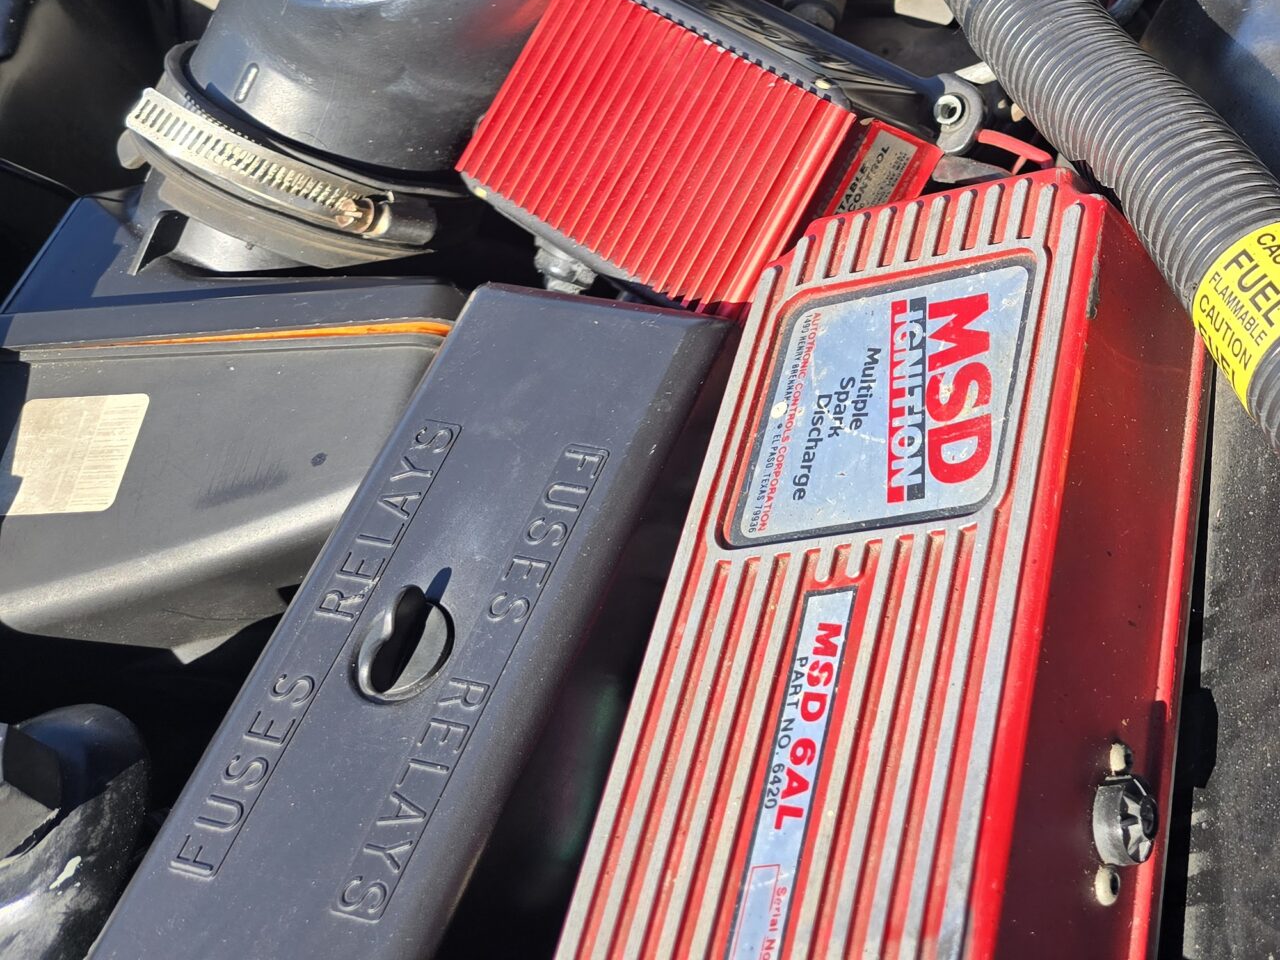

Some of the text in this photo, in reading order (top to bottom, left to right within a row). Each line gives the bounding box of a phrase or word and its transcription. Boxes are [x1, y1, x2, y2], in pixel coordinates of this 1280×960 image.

[800, 312, 822, 378] AUTOTRONIC
[1199, 294, 1252, 371] CAUTION
[1208, 271, 1268, 347] FLAMMABLE
[780, 382, 804, 444] CONTROLS
[828, 376, 856, 438] Spark
[849, 347, 882, 430] Multiple
[890, 304, 926, 492] IGNITION
[925, 292, 992, 485] MSD
[772, 433, 783, 445] EL
[792, 393, 833, 501] Discharge
[314, 425, 456, 623] RELAYS
[748, 504, 763, 534] 79936
[757, 472, 772, 501] TEXAS
[757, 445, 788, 533] CORPORATION
[487, 447, 603, 623] FUSES
[764, 656, 808, 810] PART NO. 6420
[773, 621, 843, 830] MSD 6AL
[171, 672, 316, 875] FUSES
[339, 676, 491, 914] RELAYS
